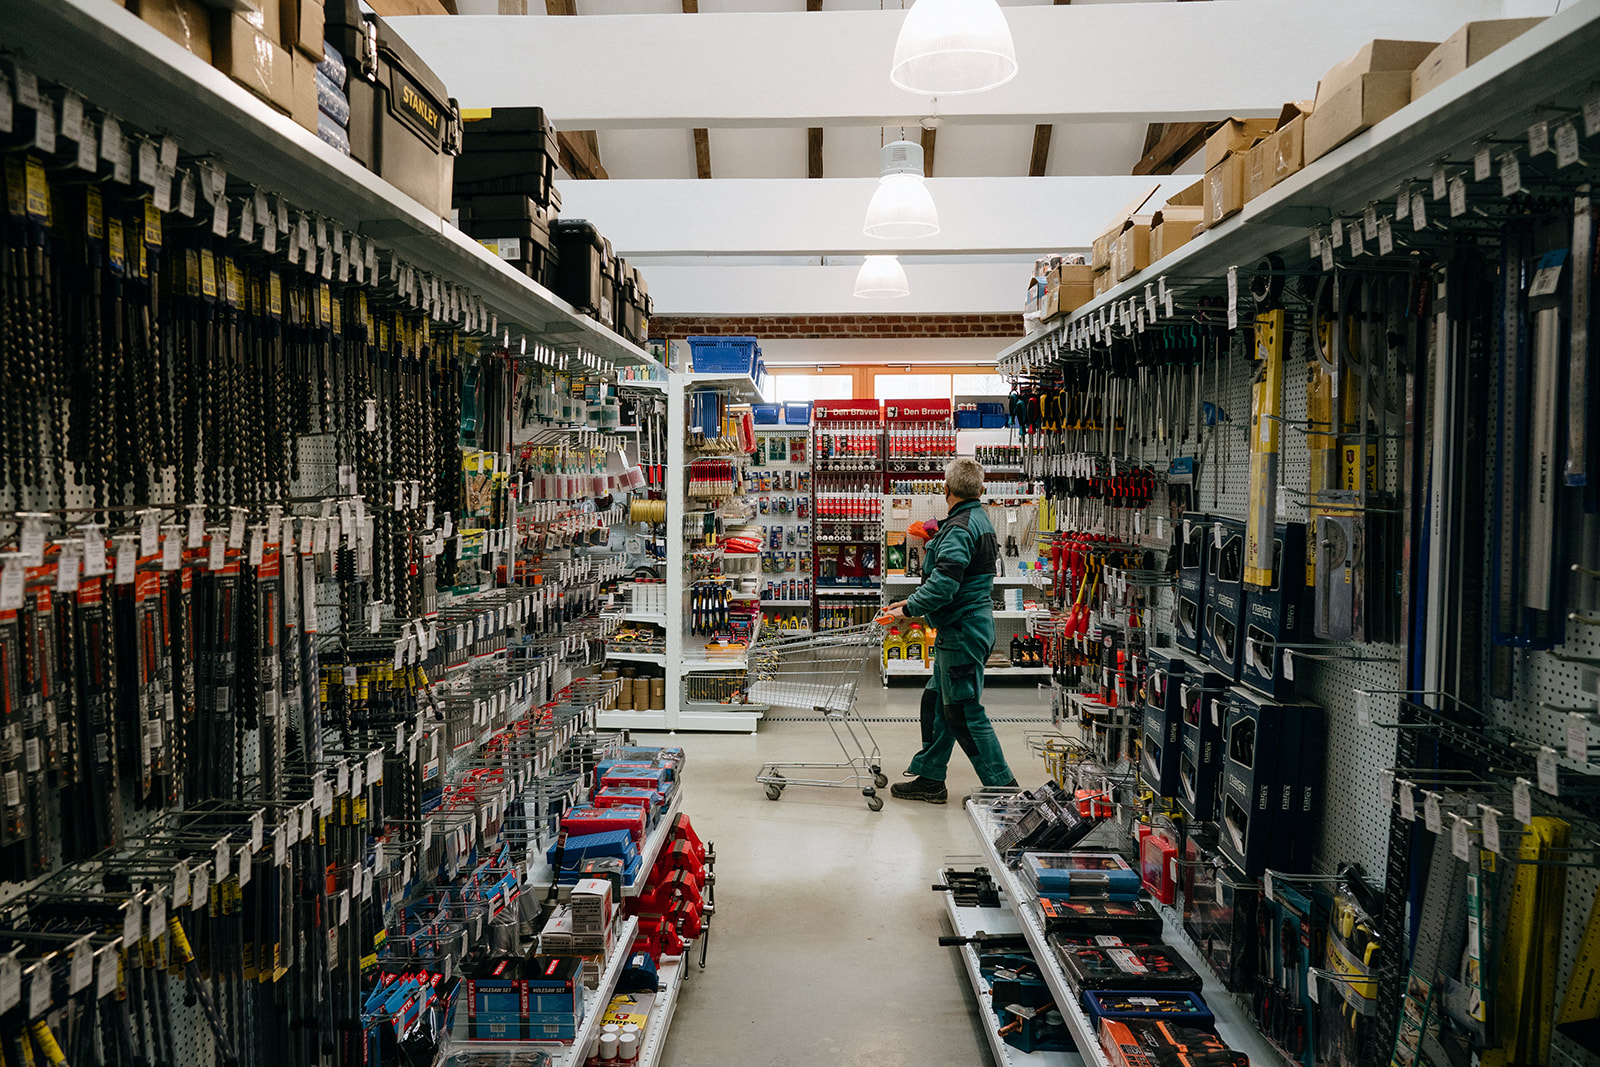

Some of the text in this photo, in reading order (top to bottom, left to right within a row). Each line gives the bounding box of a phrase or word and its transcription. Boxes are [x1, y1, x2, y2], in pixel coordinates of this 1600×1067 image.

[403, 85, 438, 129] STANLEY
[851, 407, 879, 416] Braven
[903, 407, 950, 415] Den Braven
[1252, 603, 1273, 620] narex
[521, 981, 529, 1017] FESTA
